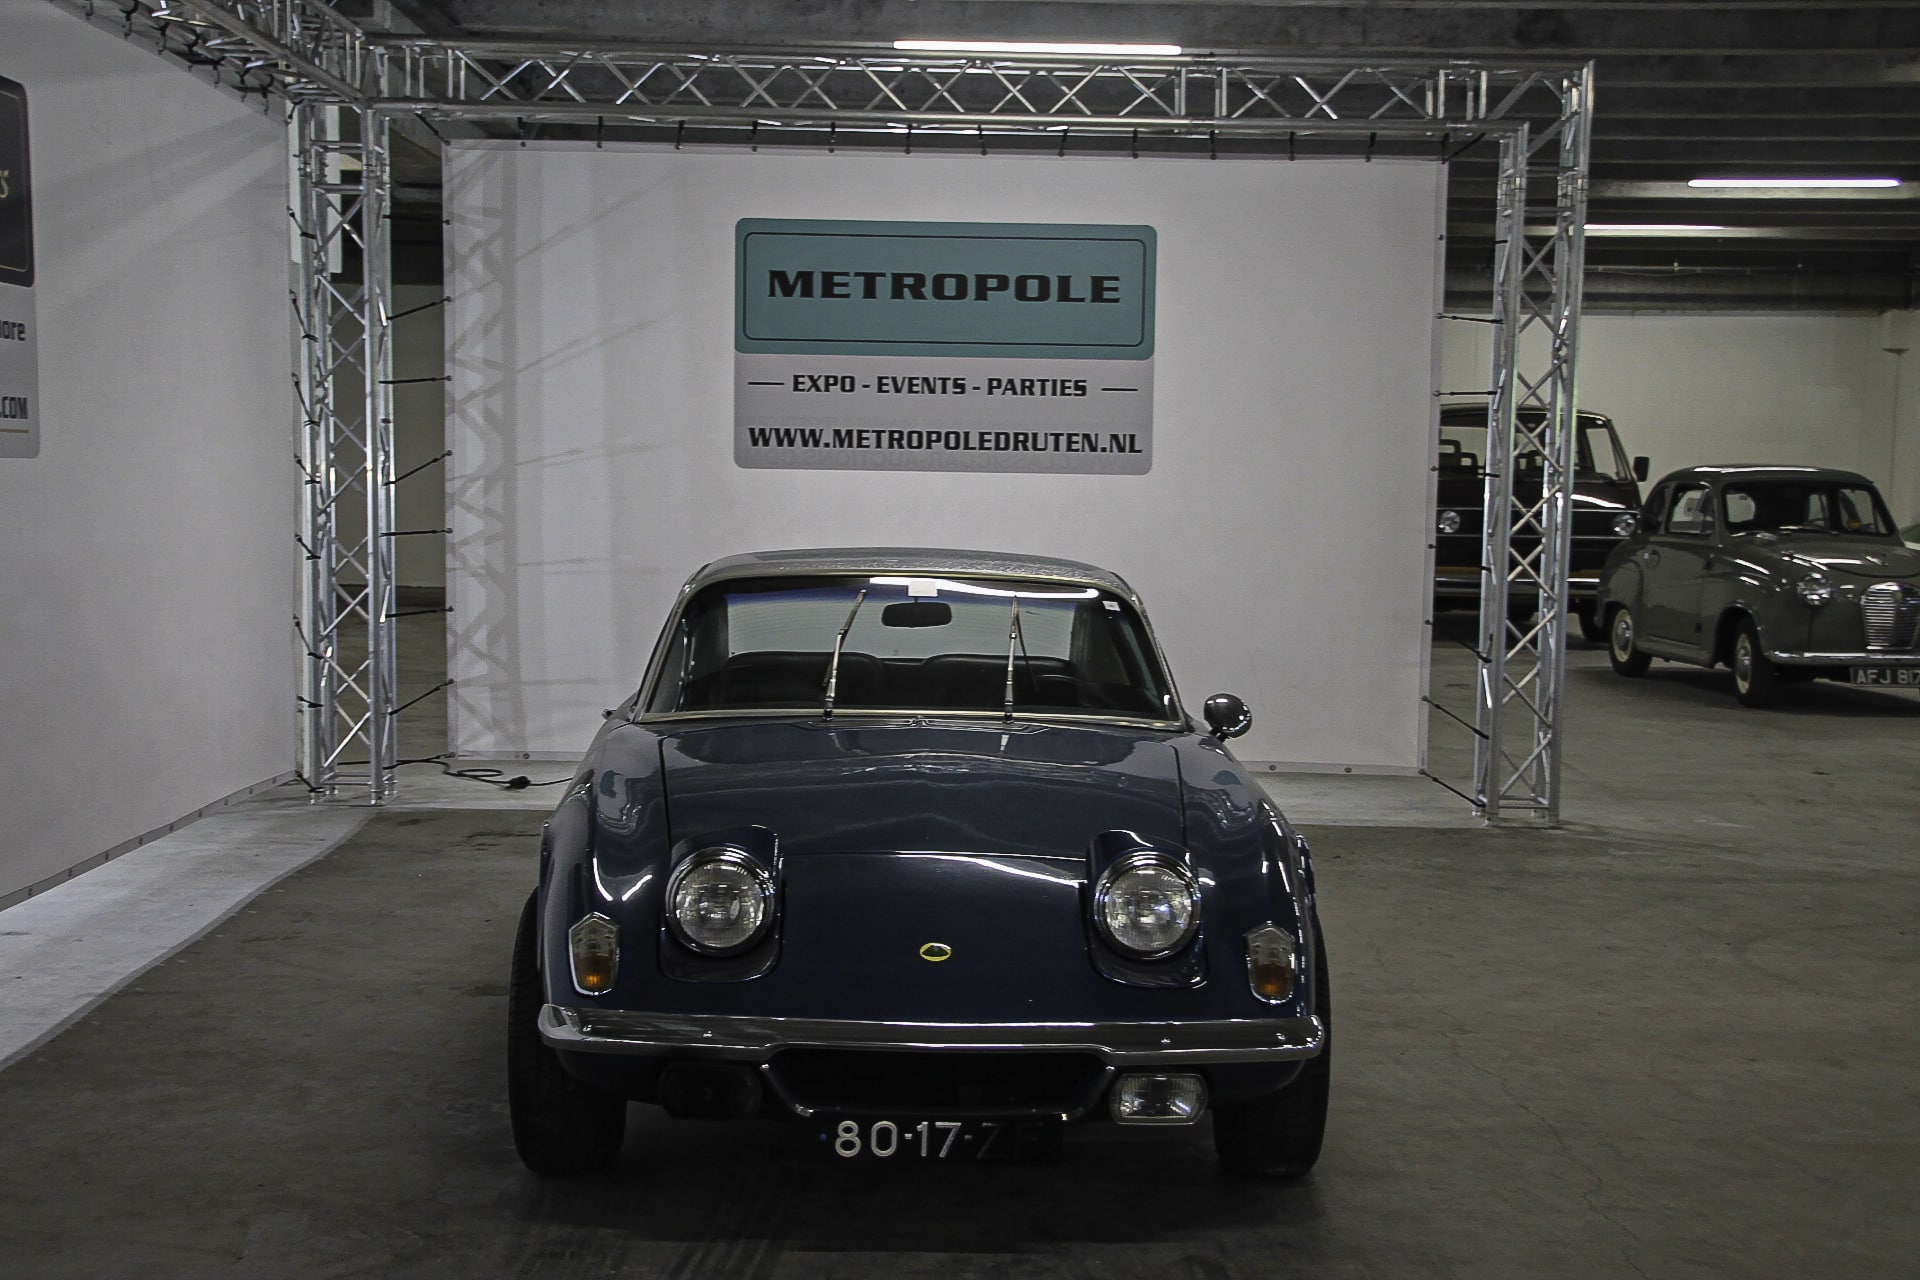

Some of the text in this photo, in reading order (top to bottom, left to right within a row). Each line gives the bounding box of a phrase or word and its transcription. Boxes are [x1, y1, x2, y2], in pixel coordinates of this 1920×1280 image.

[767, 269, 1121, 304] METROPOLE
[792, 374, 856, 393] EXPO
[876, 375, 967, 395] EVENTS
[986, 377, 1087, 397] PARTIES
[747, 427, 1143, 454] WWW.METROPOLEDRUTEN.NL
[1856, 669, 1891, 684] AFJ
